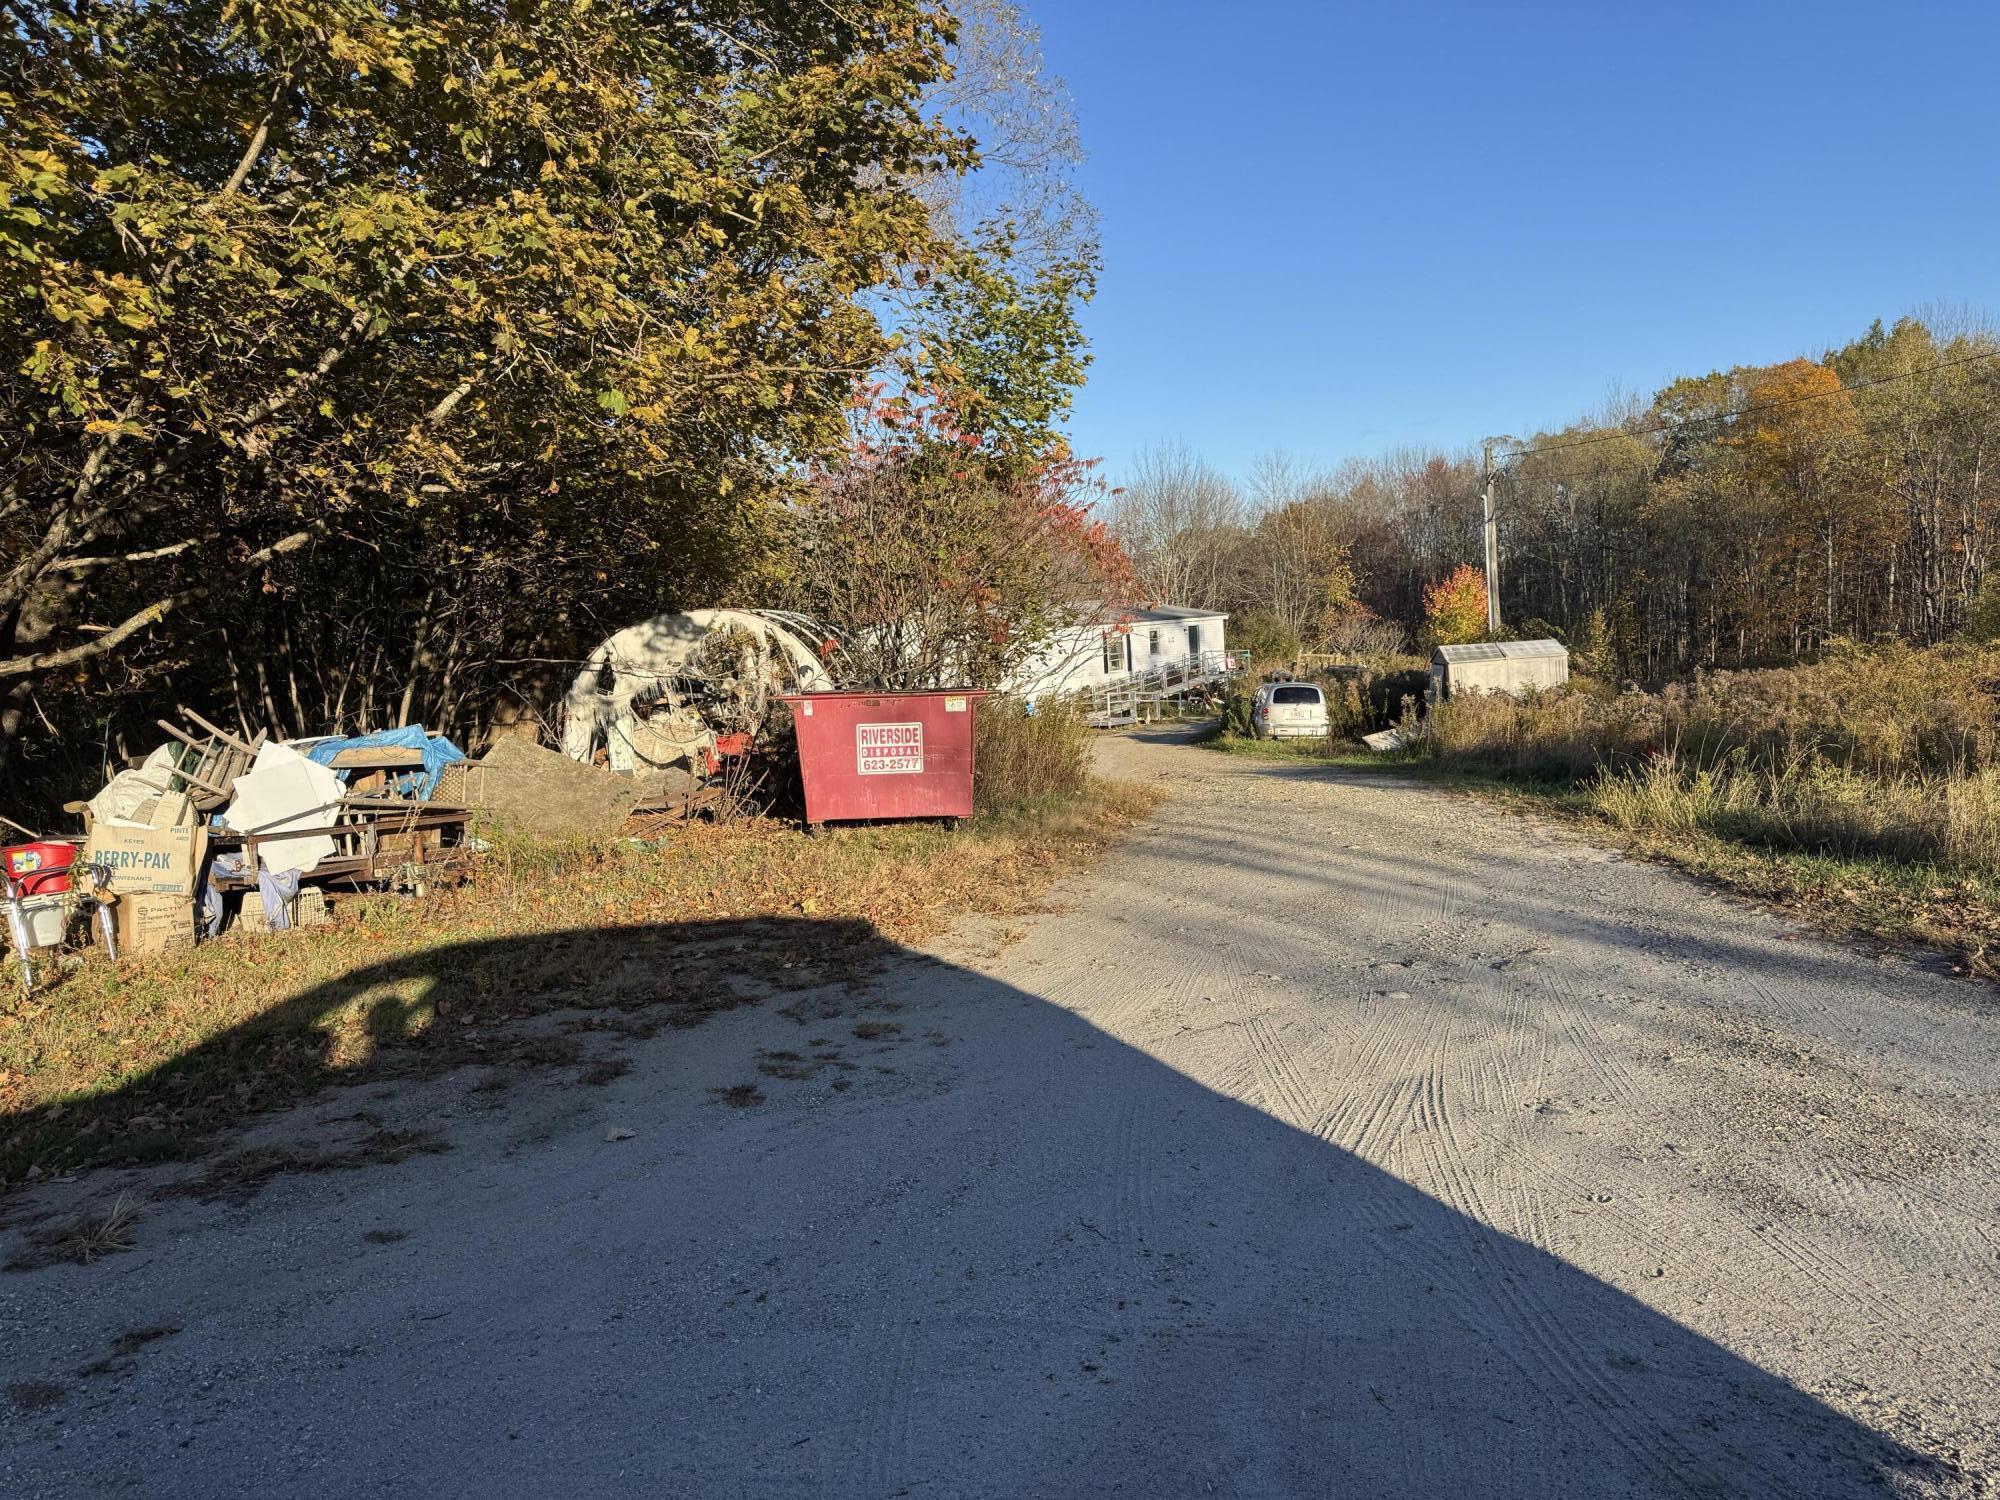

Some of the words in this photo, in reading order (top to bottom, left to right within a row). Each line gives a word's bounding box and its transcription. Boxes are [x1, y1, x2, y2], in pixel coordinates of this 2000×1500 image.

[861, 728, 919, 745] RIVERSIDE
[862, 747, 919, 757] DISPOSAL
[95, 850, 171, 869] BERRY-PAK
